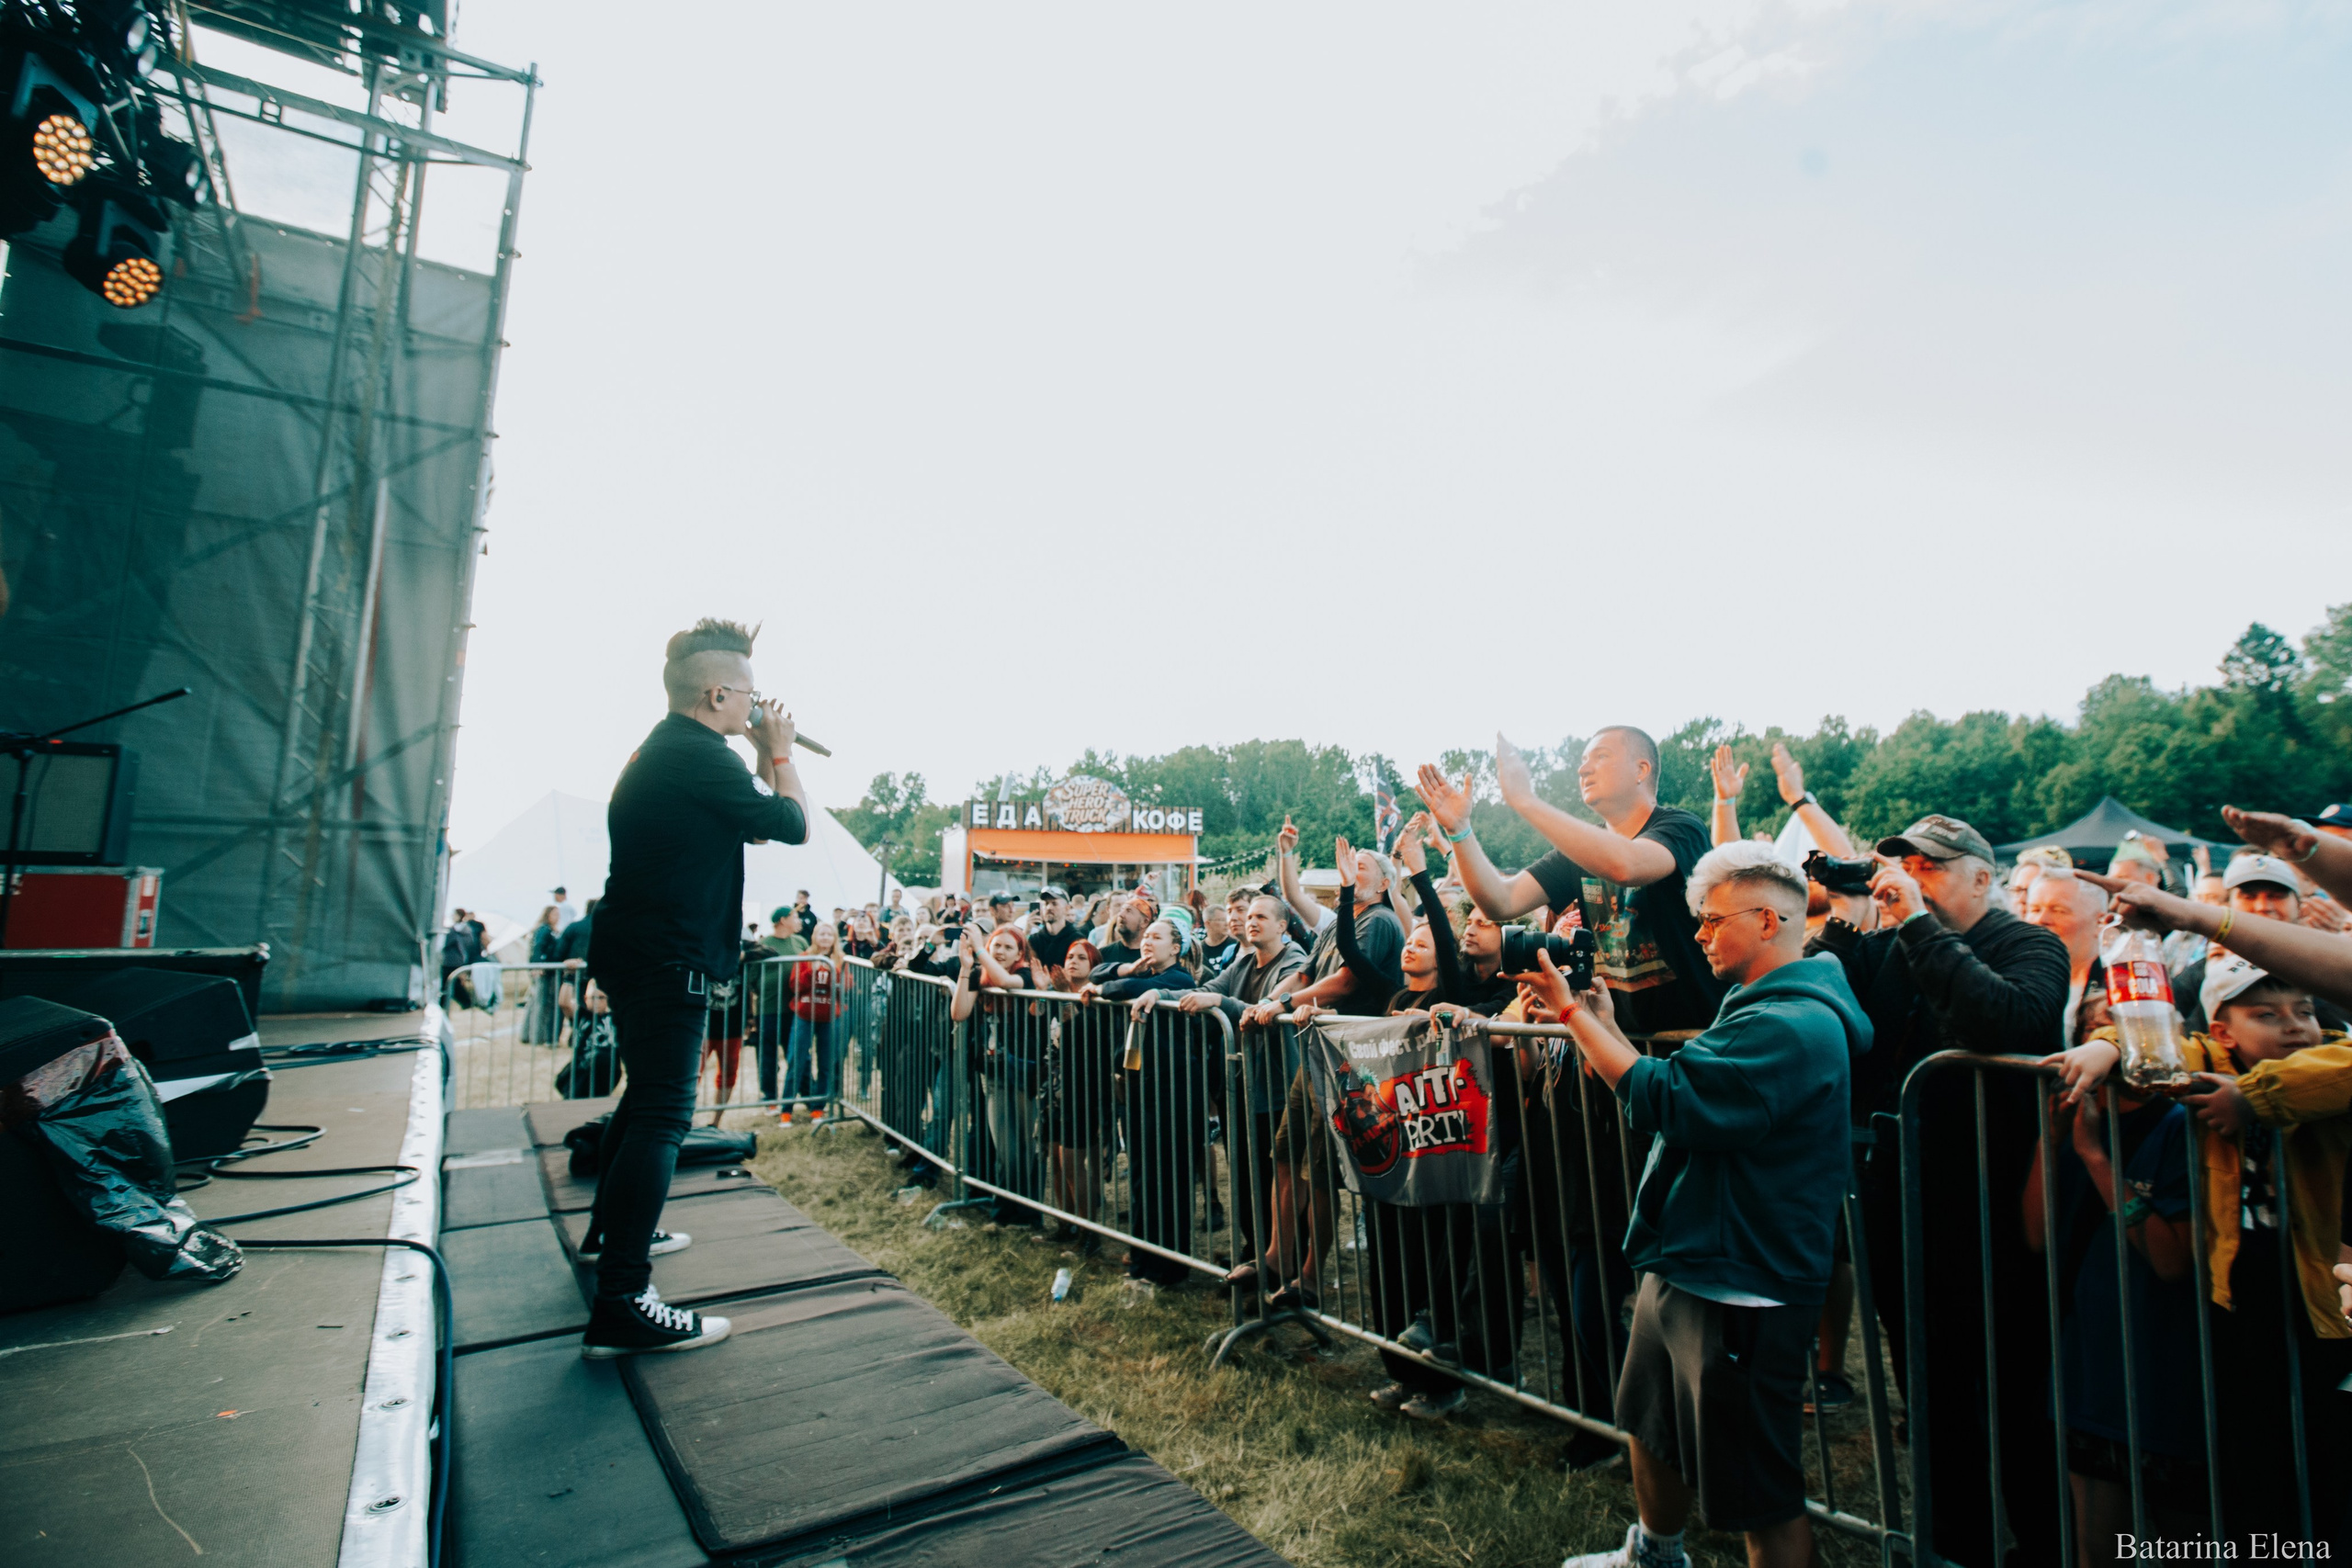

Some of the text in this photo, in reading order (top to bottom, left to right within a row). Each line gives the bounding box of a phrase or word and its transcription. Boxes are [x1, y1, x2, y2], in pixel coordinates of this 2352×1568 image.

[1062, 782, 1109, 800] SUPER
[1069, 796, 1105, 809] HERO
[972, 805, 1042, 829] ЕДА
[1064, 808, 1109, 826] TRUCK
[1133, 809, 1203, 830] КОФЕ
[1348, 1039, 1378, 1059] Свой
